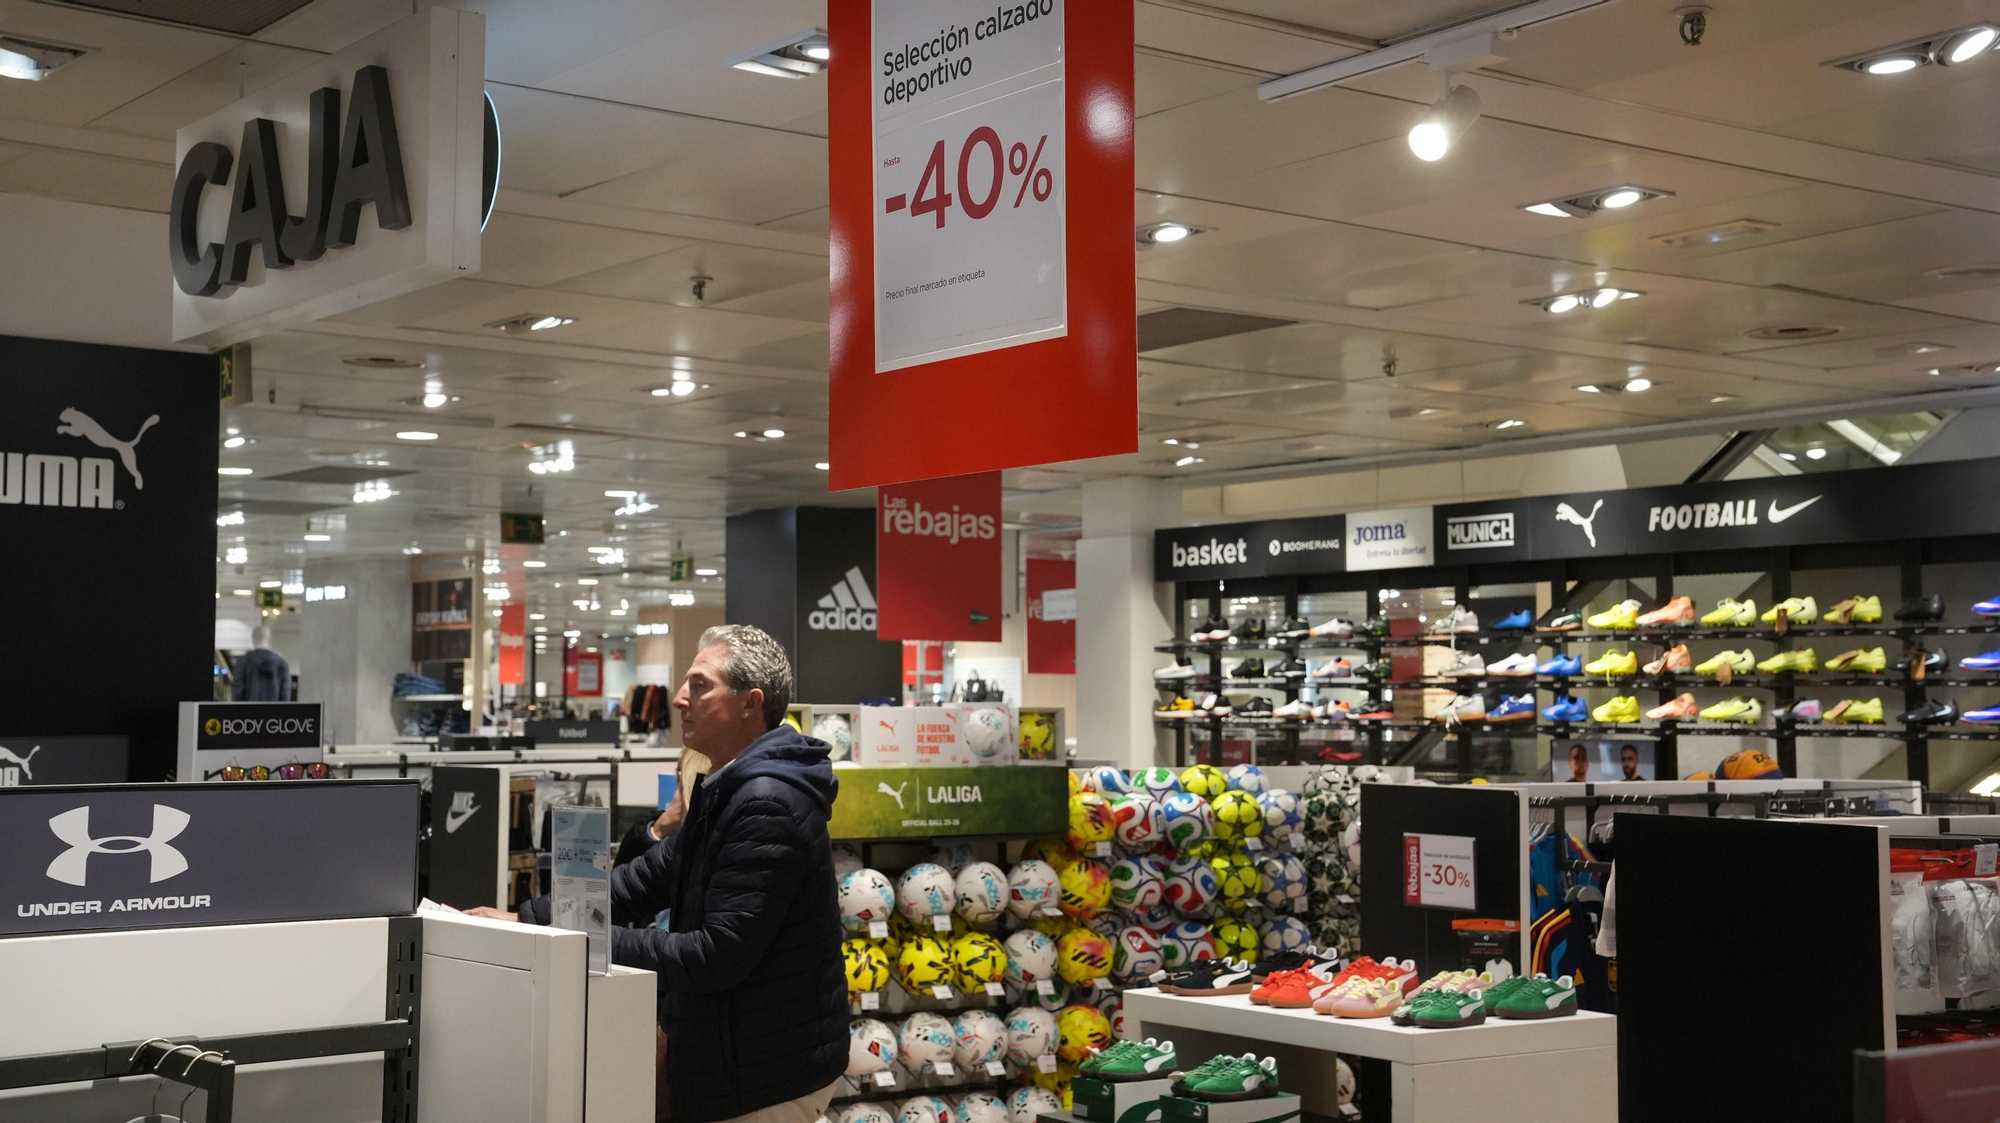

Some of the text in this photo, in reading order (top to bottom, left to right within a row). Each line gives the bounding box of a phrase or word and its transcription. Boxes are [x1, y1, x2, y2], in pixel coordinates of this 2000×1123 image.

[883, 0, 1053, 76] Selección calzado
[884, 56, 972, 105] deportivo
[883, 155, 901, 168] Hasta
[169, 65, 412, 297] CAJA
[885, 126, 1053, 230] -40%
[885, 269, 986, 301] Precio final marcado en etiqueta
[884, 493, 907, 509] Las
[884, 502, 996, 545] rebajas
[1648, 499, 1758, 532] FOOTBALL
[1447, 518, 1515, 544] MUNICH
[1172, 537, 1247, 568] basket
[1282, 538, 1340, 552] BOOMERANG
[808, 606, 878, 631] adida
[223, 718, 314, 734] BODY GLOVE
[927, 785, 982, 803] LALIGA
[1424, 864, 1470, 888] -30%
[17, 895, 211, 917] UNDER ARMOUR
